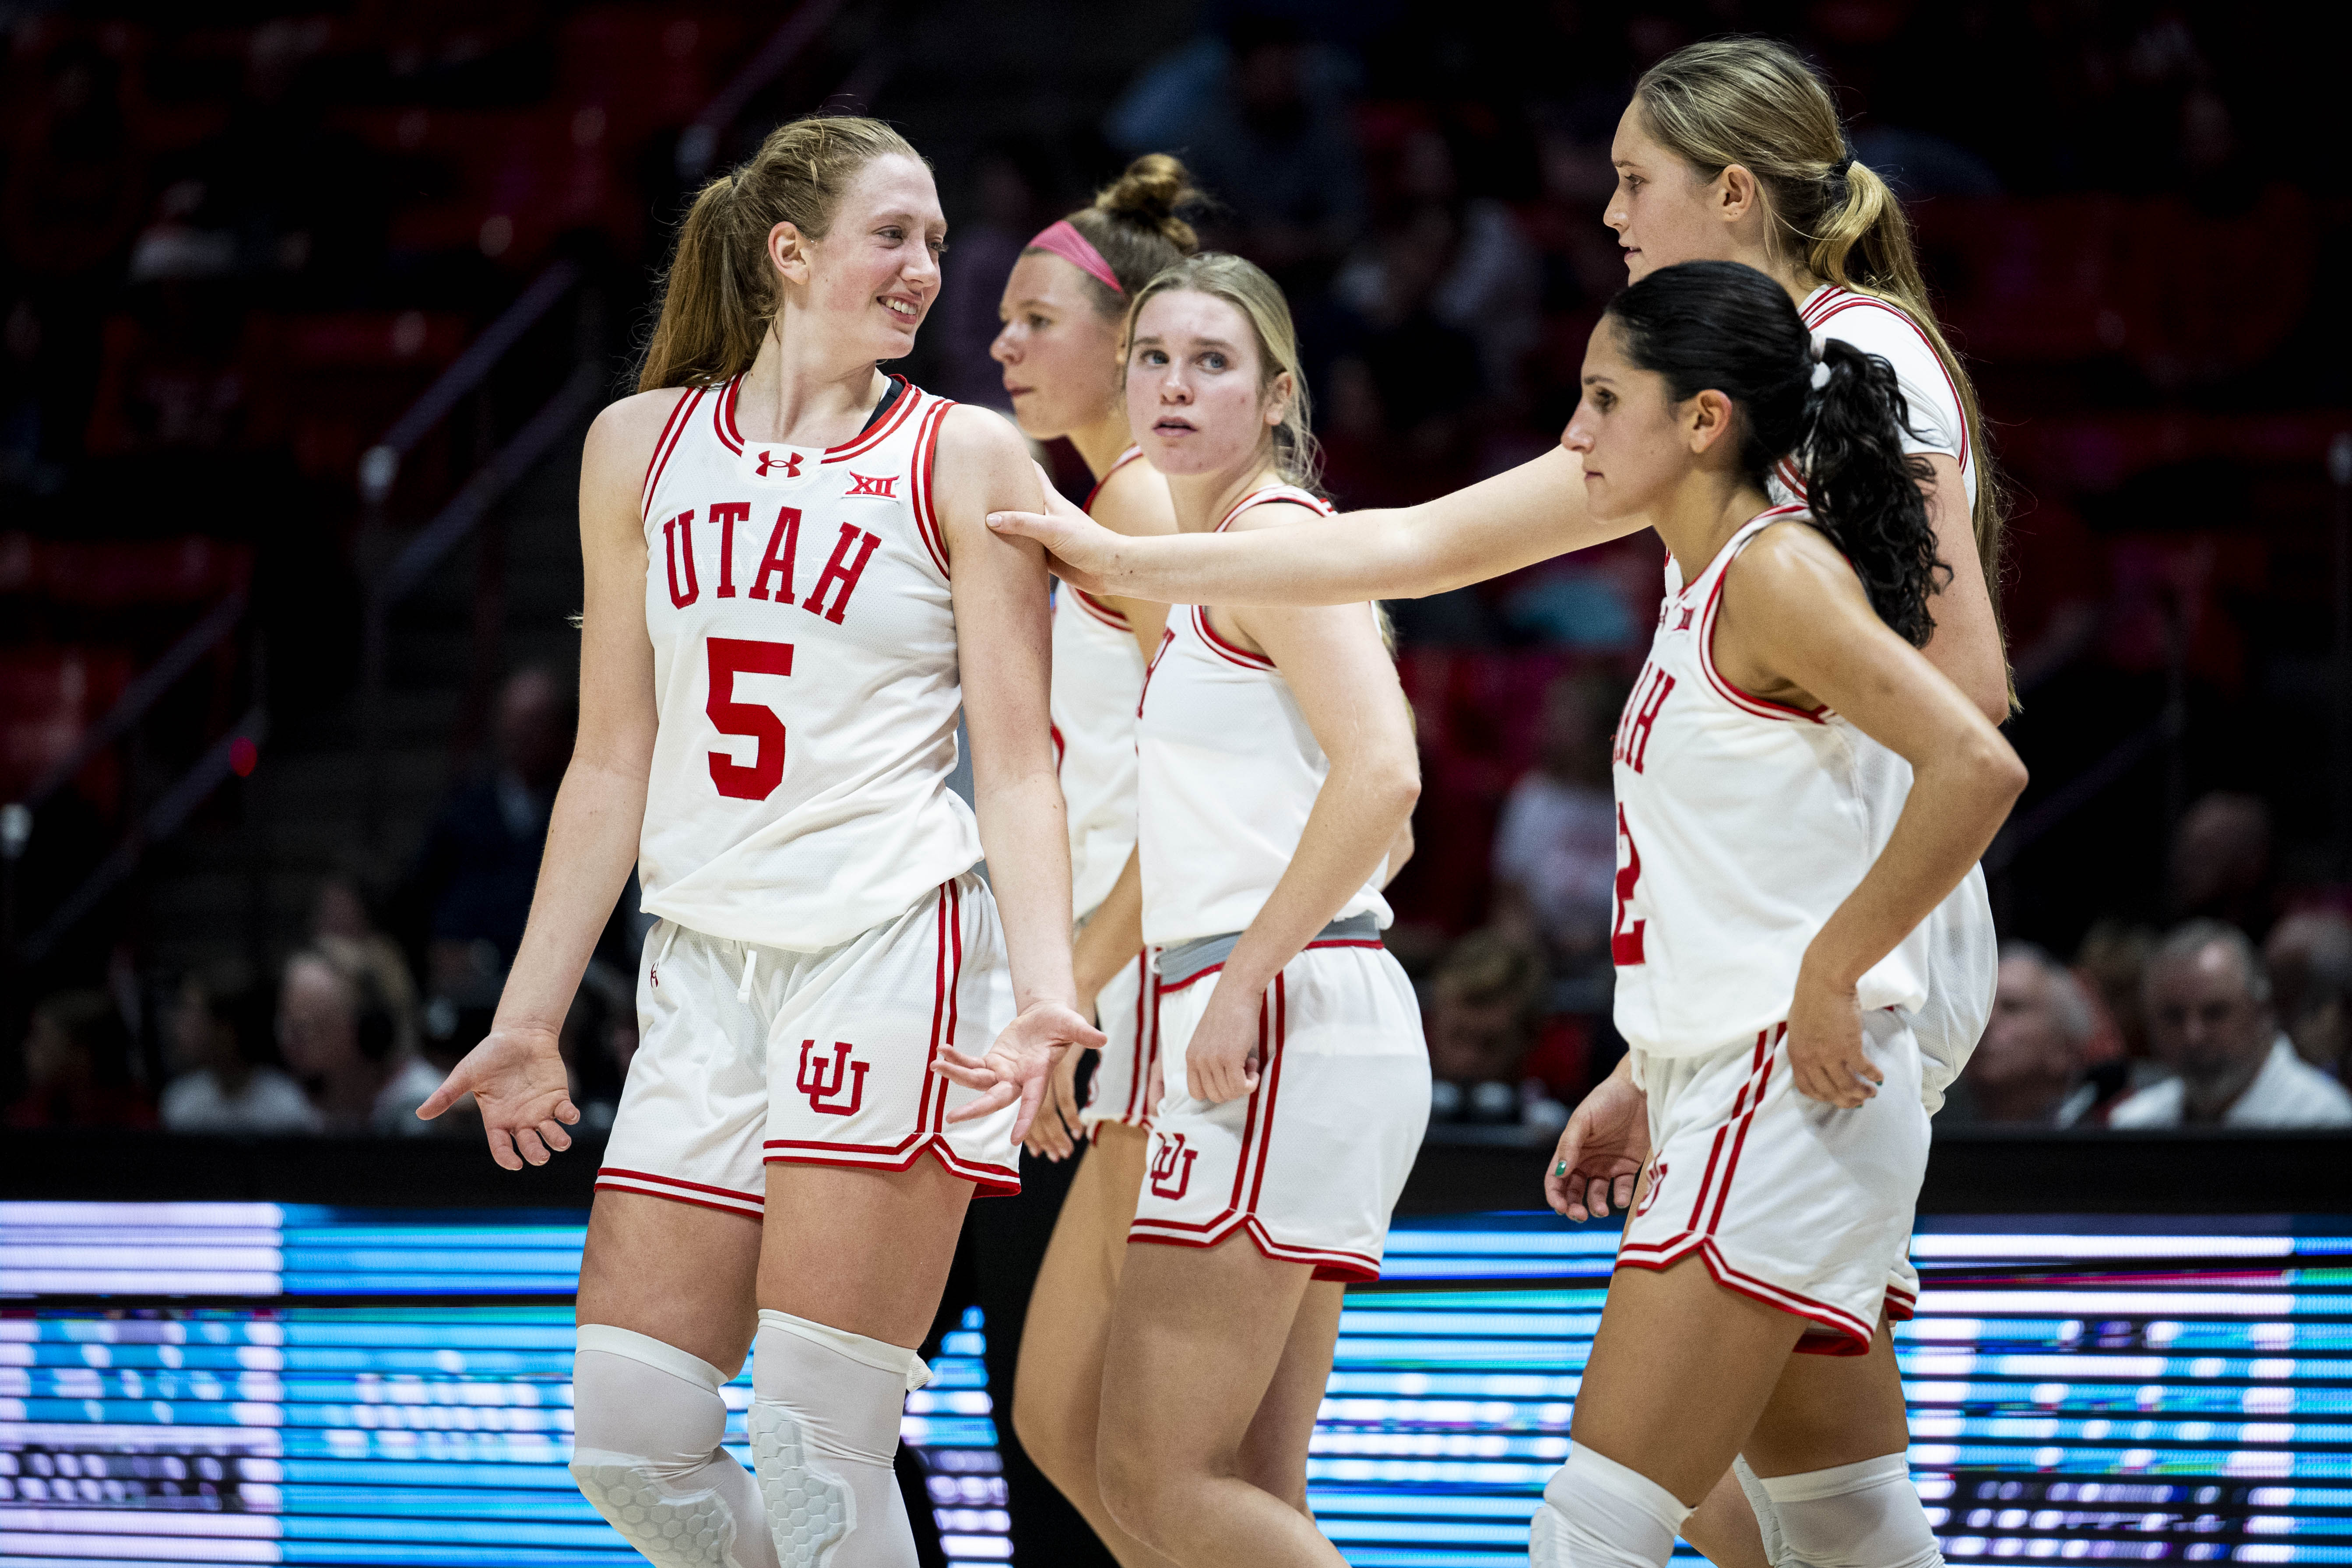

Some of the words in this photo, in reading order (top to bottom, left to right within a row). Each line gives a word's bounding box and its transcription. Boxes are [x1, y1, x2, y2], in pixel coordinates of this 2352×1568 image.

[845, 471, 900, 498] XII
[663, 502, 881, 625] UTAH
[706, 637, 794, 801] 5
